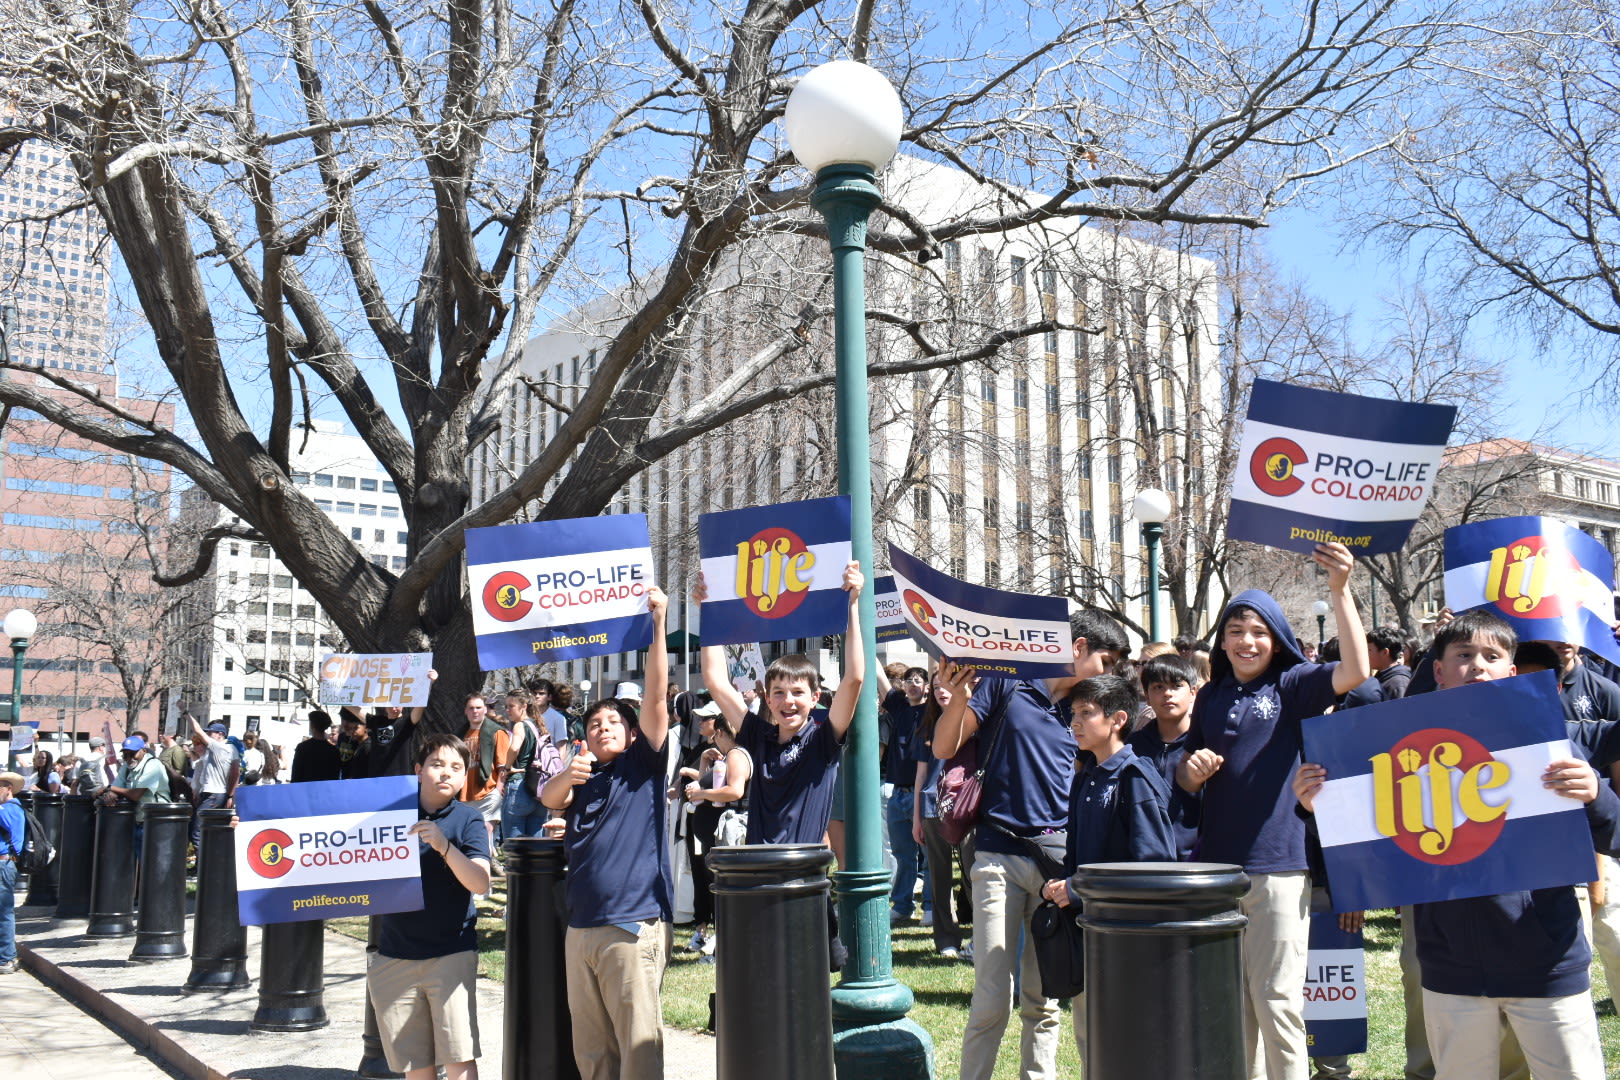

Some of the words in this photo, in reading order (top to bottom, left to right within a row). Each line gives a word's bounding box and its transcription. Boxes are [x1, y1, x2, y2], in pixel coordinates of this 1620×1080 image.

[1314, 452, 1431, 482] PRO-LIFE
[1311, 478, 1424, 502] COLORADO
[1289, 526, 1373, 548] prolifeco.org
[536, 564, 643, 591] PRO-LIFE
[735, 537, 815, 613] life
[539, 583, 644, 609] COLORADO
[875, 600, 901, 610] PRO-
[877, 608, 903, 618] COLOR
[941, 613, 1059, 643] PRO-LIFE
[531, 632, 608, 653] prolifeco.org
[942, 631, 1061, 654] COLORADO
[321, 656, 394, 679] CHOOSE
[362, 677, 415, 704] LIFE
[1368, 741, 1512, 857] life
[299, 824, 408, 850] PRO-LIFE
[300, 846, 410, 867] COLORADO
[292, 893, 370, 911] prolifeco.org
[1305, 965, 1355, 983] LIFE
[1302, 986, 1357, 1002] RADO
